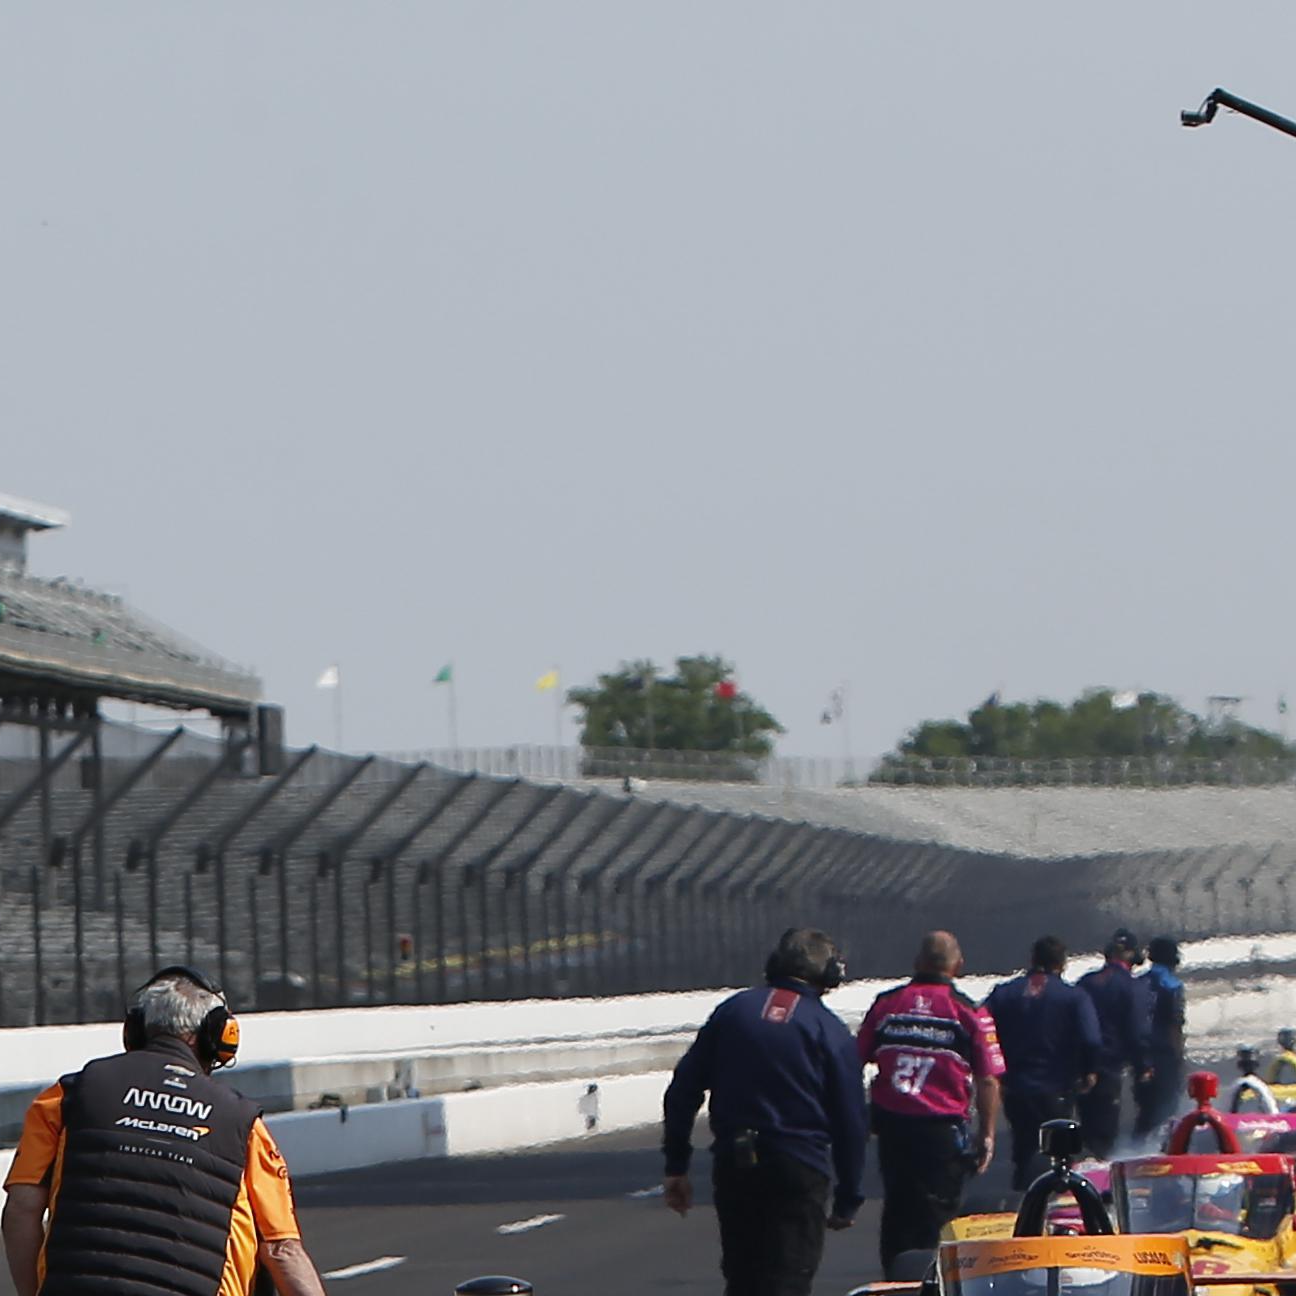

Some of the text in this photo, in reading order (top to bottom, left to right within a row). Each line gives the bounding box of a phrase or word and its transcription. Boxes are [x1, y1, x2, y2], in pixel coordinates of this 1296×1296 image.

[892, 1053, 936, 1095] 27
[123, 1087, 212, 1120] ARROW
[115, 1117, 200, 1141] McLaren
[120, 1145, 194, 1164] INDYCAR TEAM
